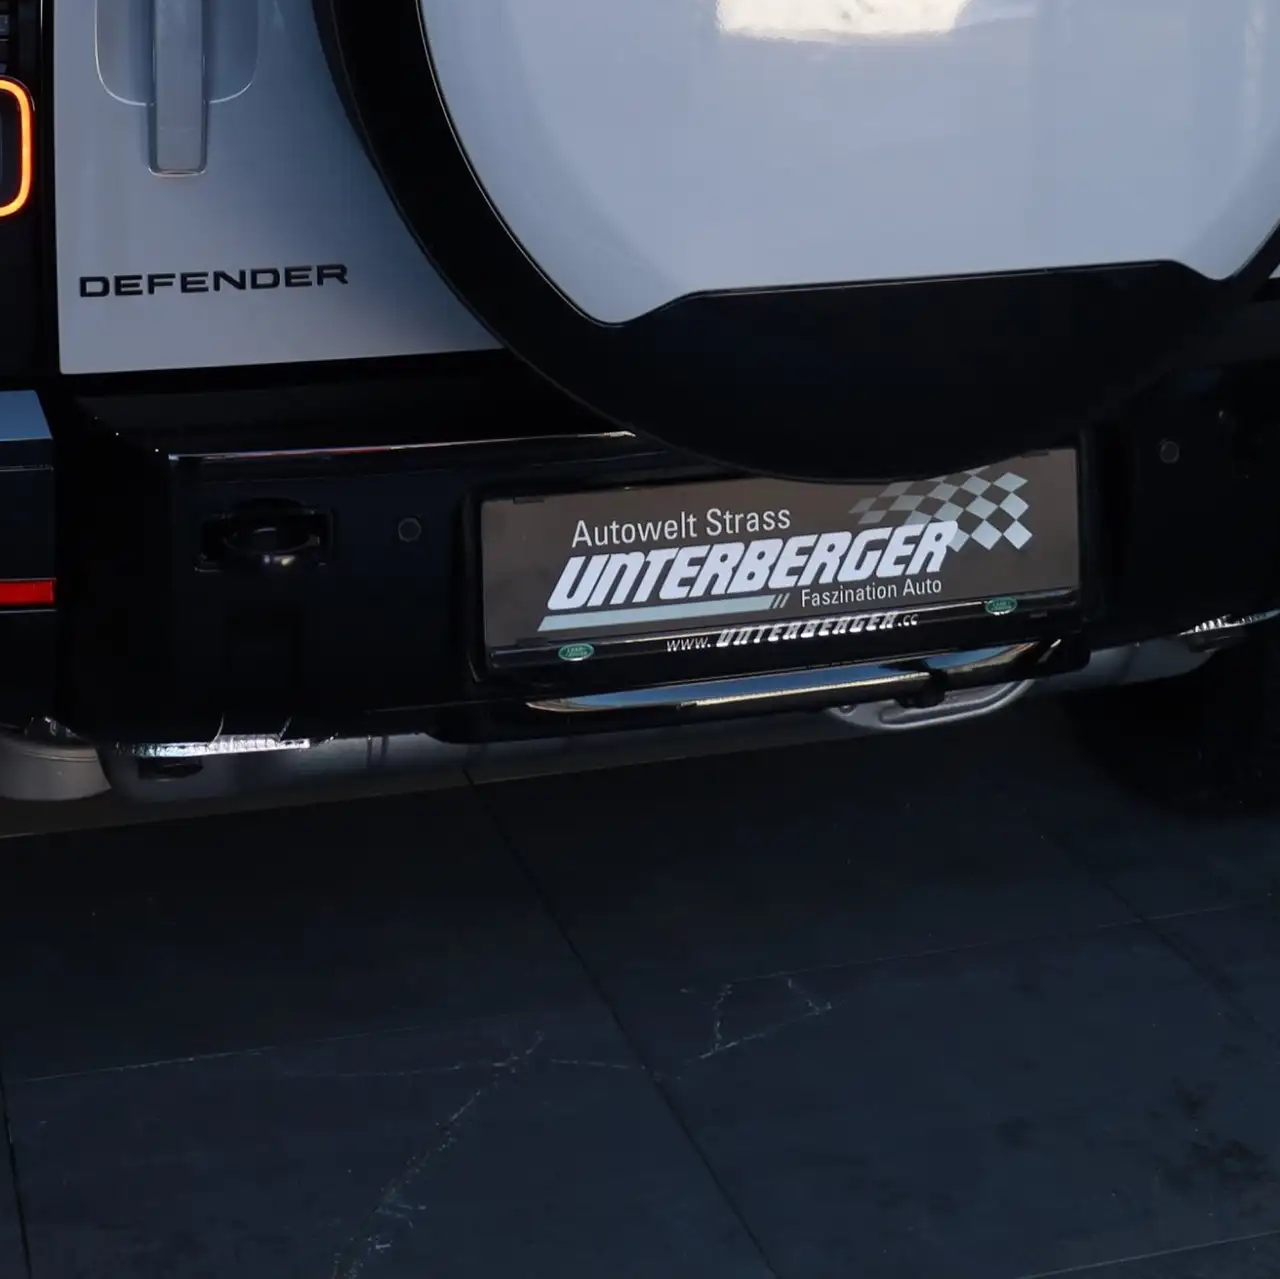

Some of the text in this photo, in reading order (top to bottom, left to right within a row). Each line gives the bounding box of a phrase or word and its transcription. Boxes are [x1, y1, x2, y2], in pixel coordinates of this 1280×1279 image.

[79, 263, 349, 298] DEFENDER
[571, 507, 792, 548] Autowelt Strass
[547, 520, 959, 611] UNTERBERGER
[800, 577, 943, 609] Faszination Auto
